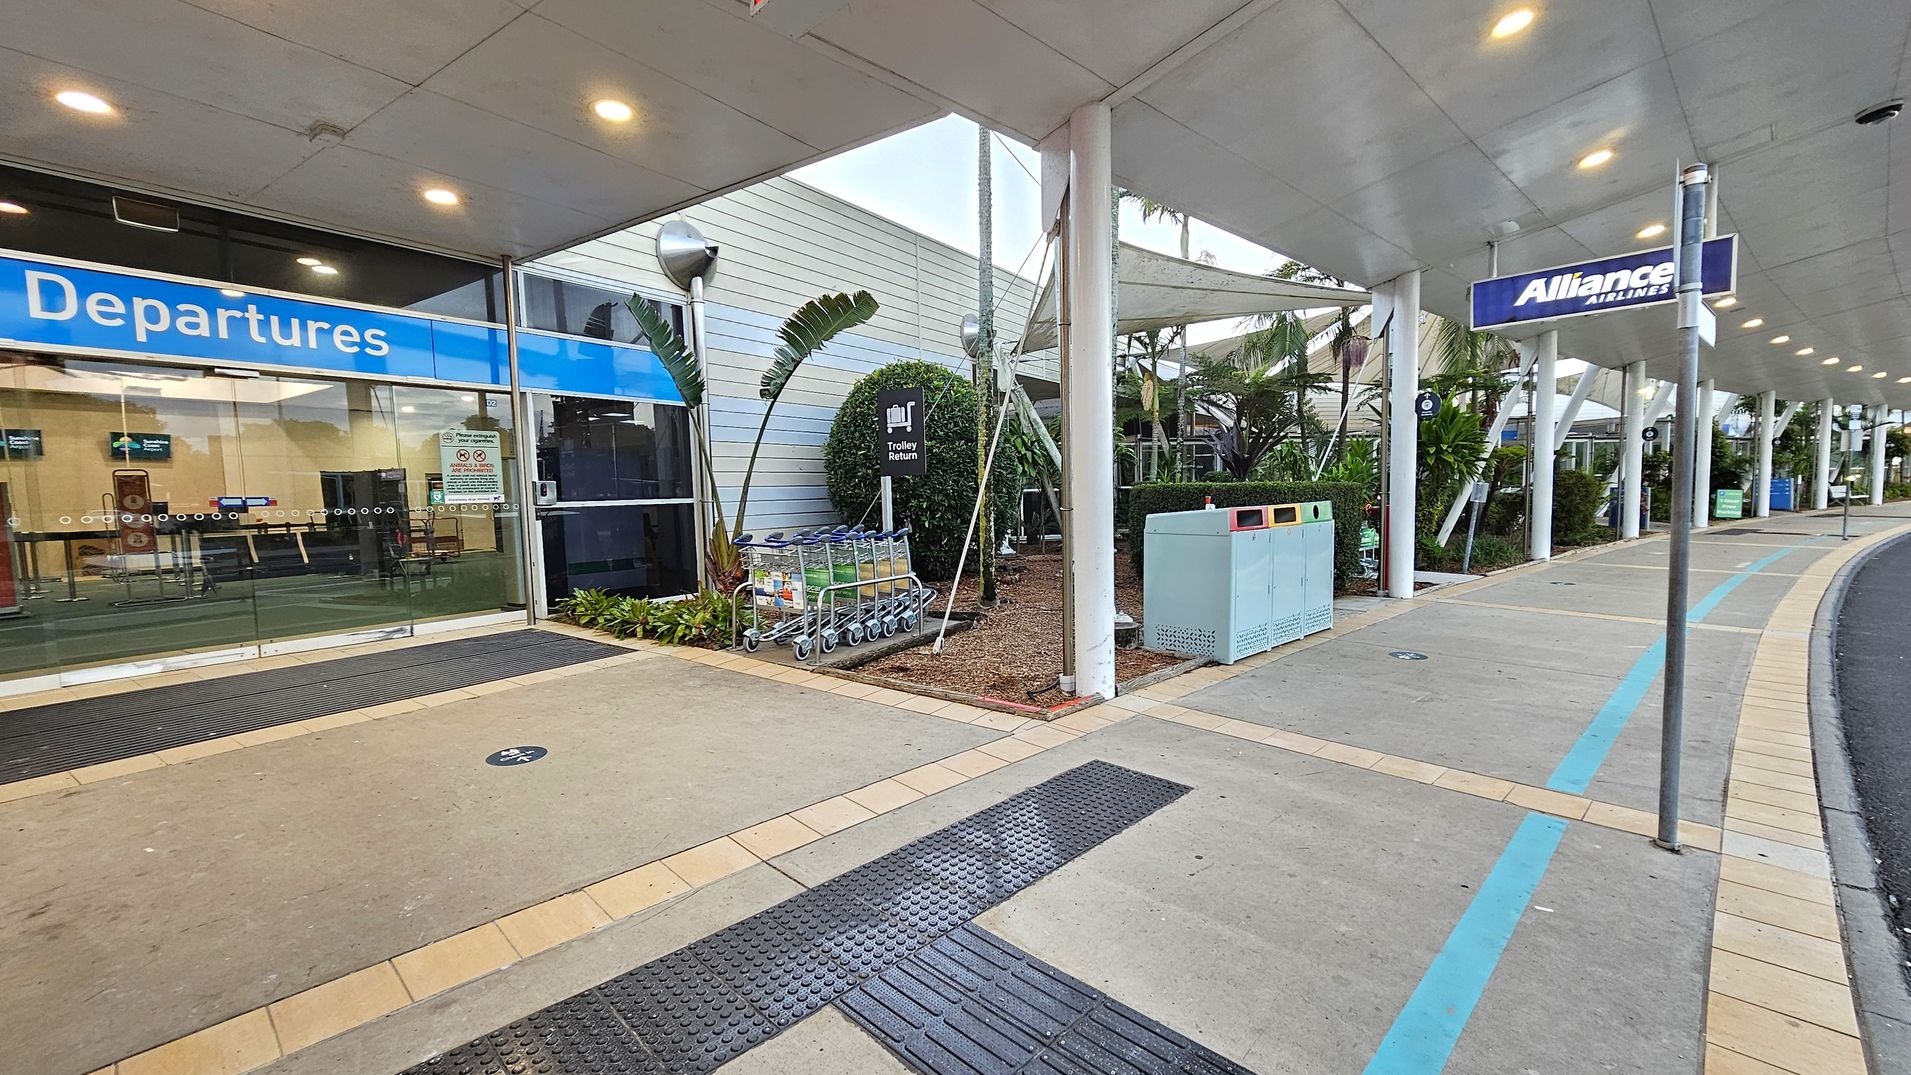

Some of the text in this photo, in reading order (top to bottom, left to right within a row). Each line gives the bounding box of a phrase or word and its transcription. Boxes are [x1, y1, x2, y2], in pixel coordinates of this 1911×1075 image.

[1513, 261, 1675, 306] Alliance
[1584, 284, 1670, 305] AIRLINES
[25, 269, 390, 357] Departures
[887, 440, 917, 451] Trolley
[888, 451, 918, 461] Return
